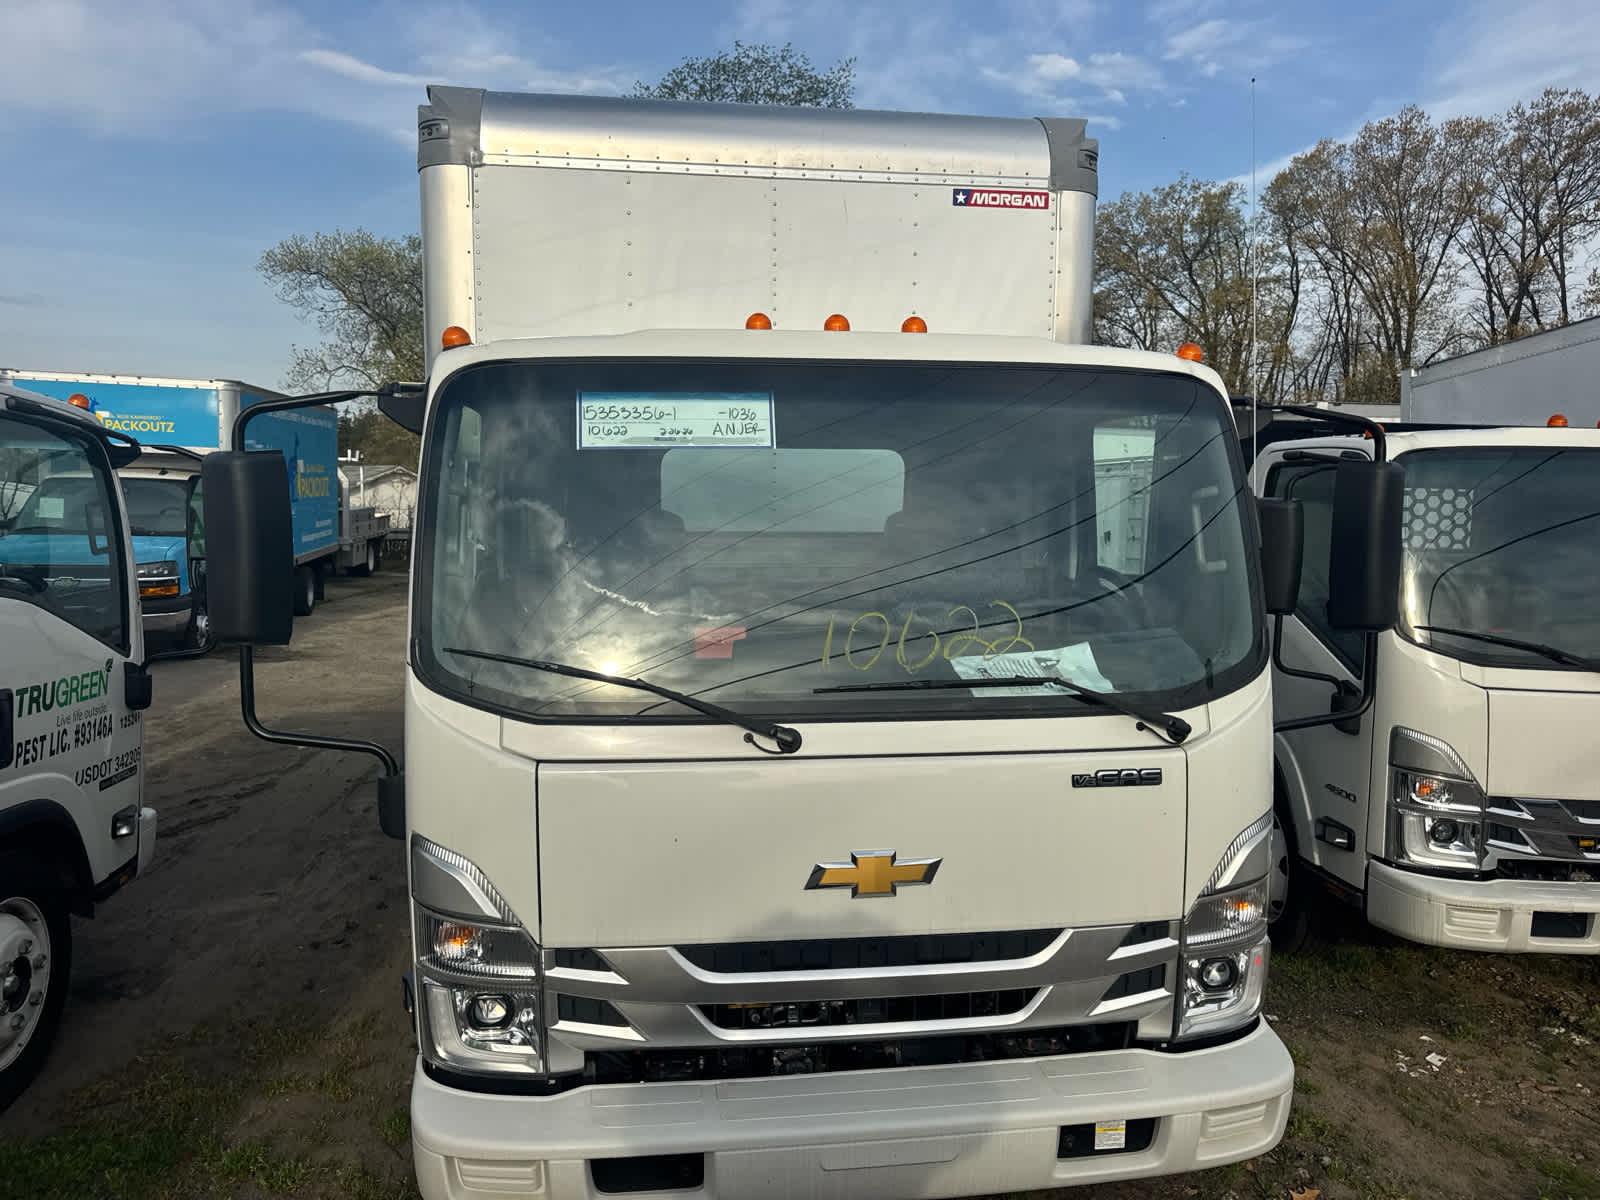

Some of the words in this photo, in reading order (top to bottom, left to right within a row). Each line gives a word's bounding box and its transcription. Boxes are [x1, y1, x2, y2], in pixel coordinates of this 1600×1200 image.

[970, 191, 1046, 208] MORGAN
[105, 419, 175, 433] PACKOUTZ
[588, 425, 628, 437] 10622
[821, 601, 1035, 673] 10622
[15, 670, 109, 718] TRUGREEN
[15, 735, 47, 769] PEST
[74, 713, 113, 749] #93146A
[75, 758, 113, 787] USDOT
